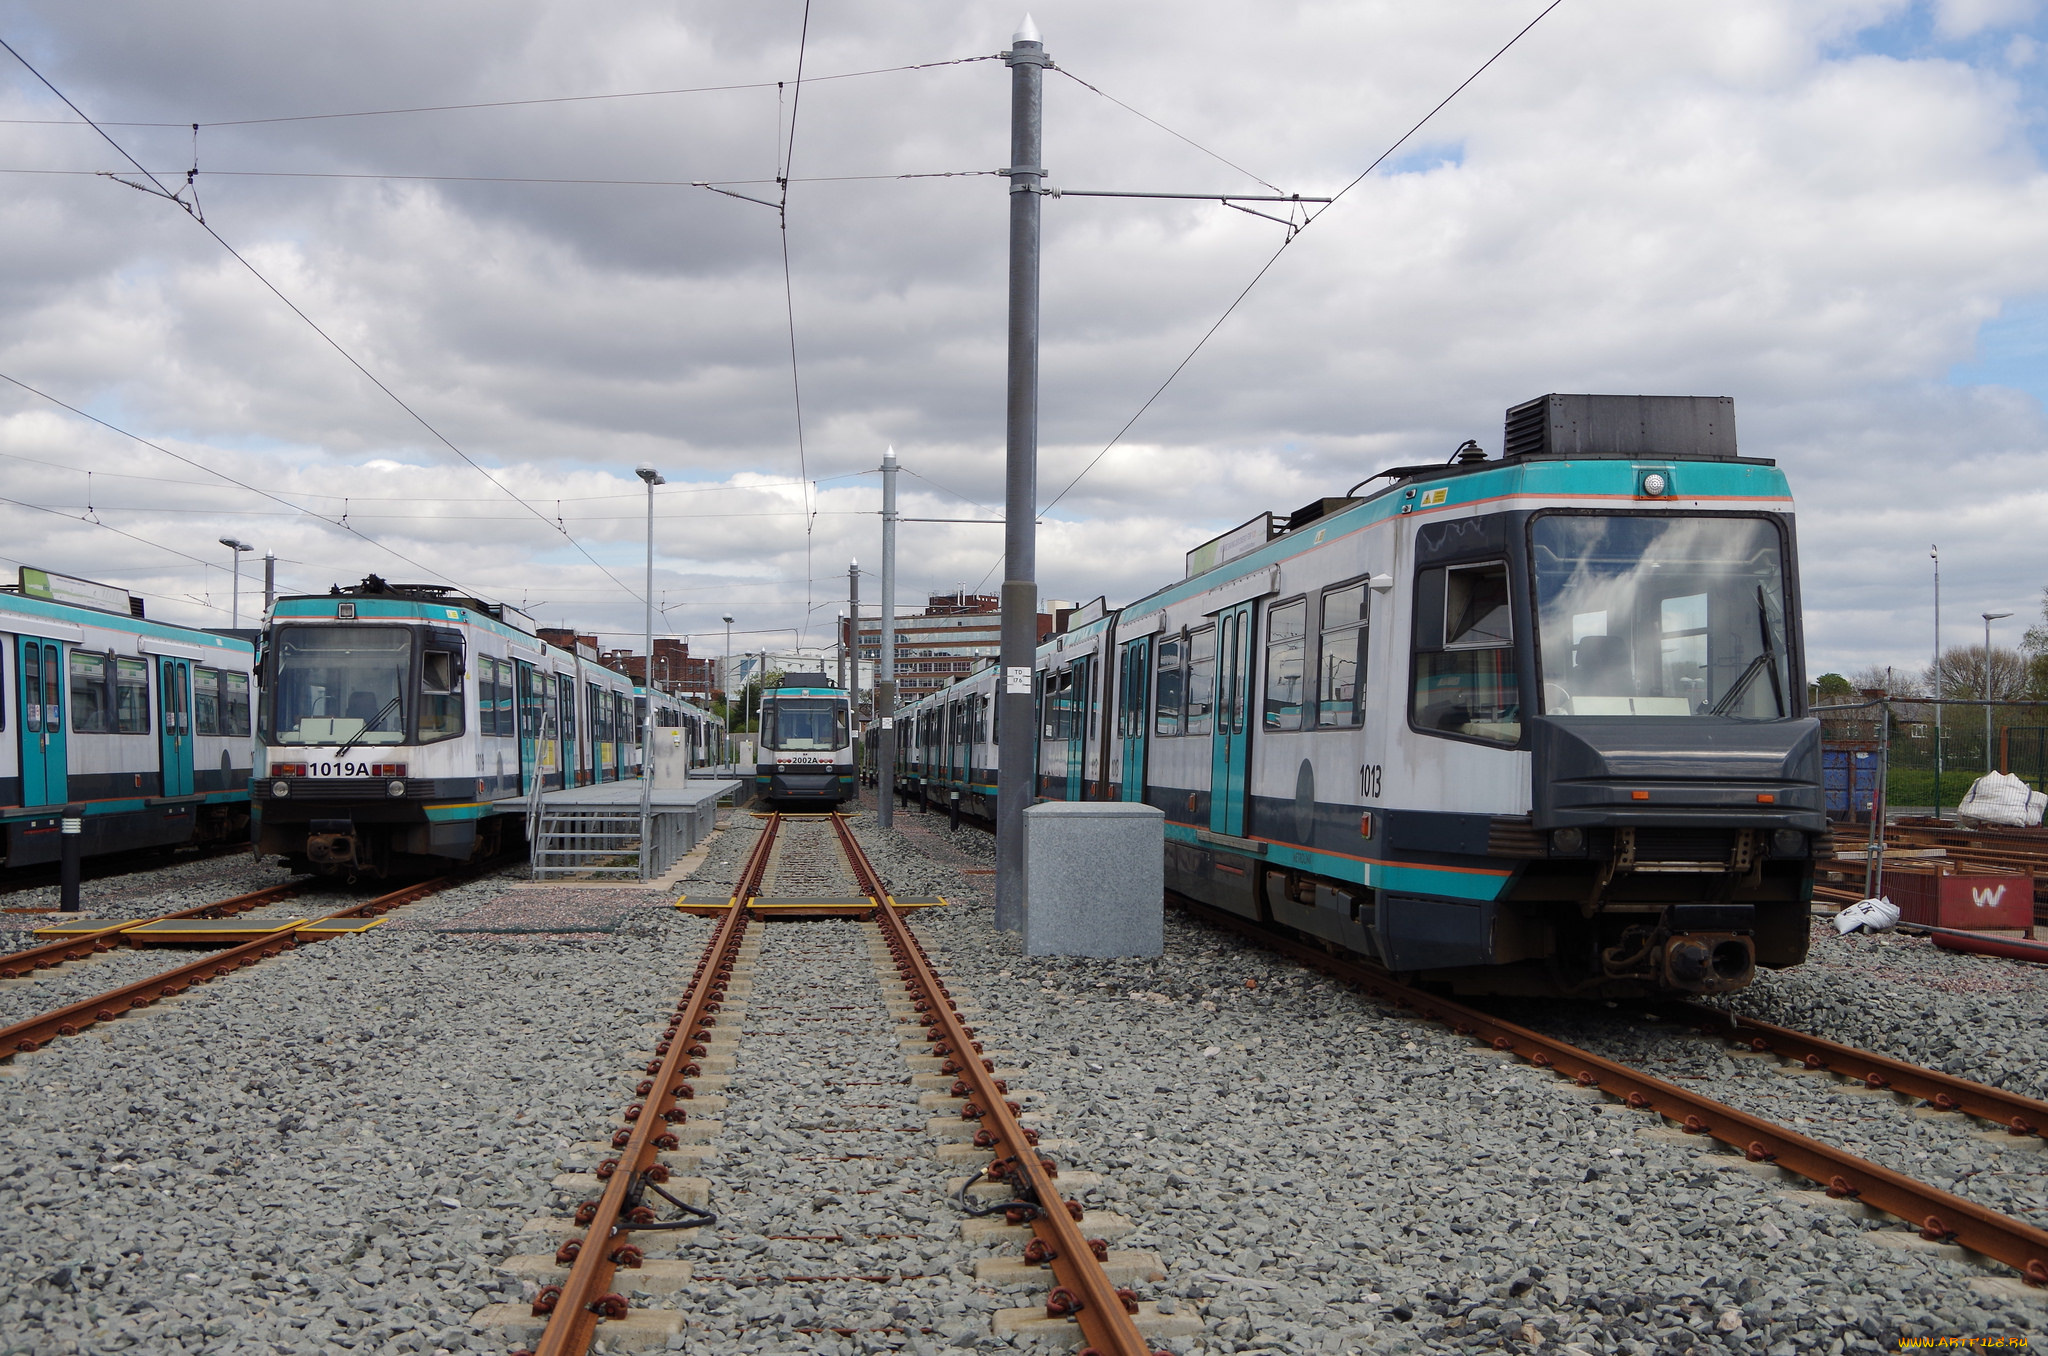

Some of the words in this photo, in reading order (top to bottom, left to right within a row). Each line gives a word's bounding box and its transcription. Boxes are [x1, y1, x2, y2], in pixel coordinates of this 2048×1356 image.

[309, 762, 370, 777] 1019A
[1359, 763, 1382, 799] 1013
[1971, 884, 2007, 908] W
